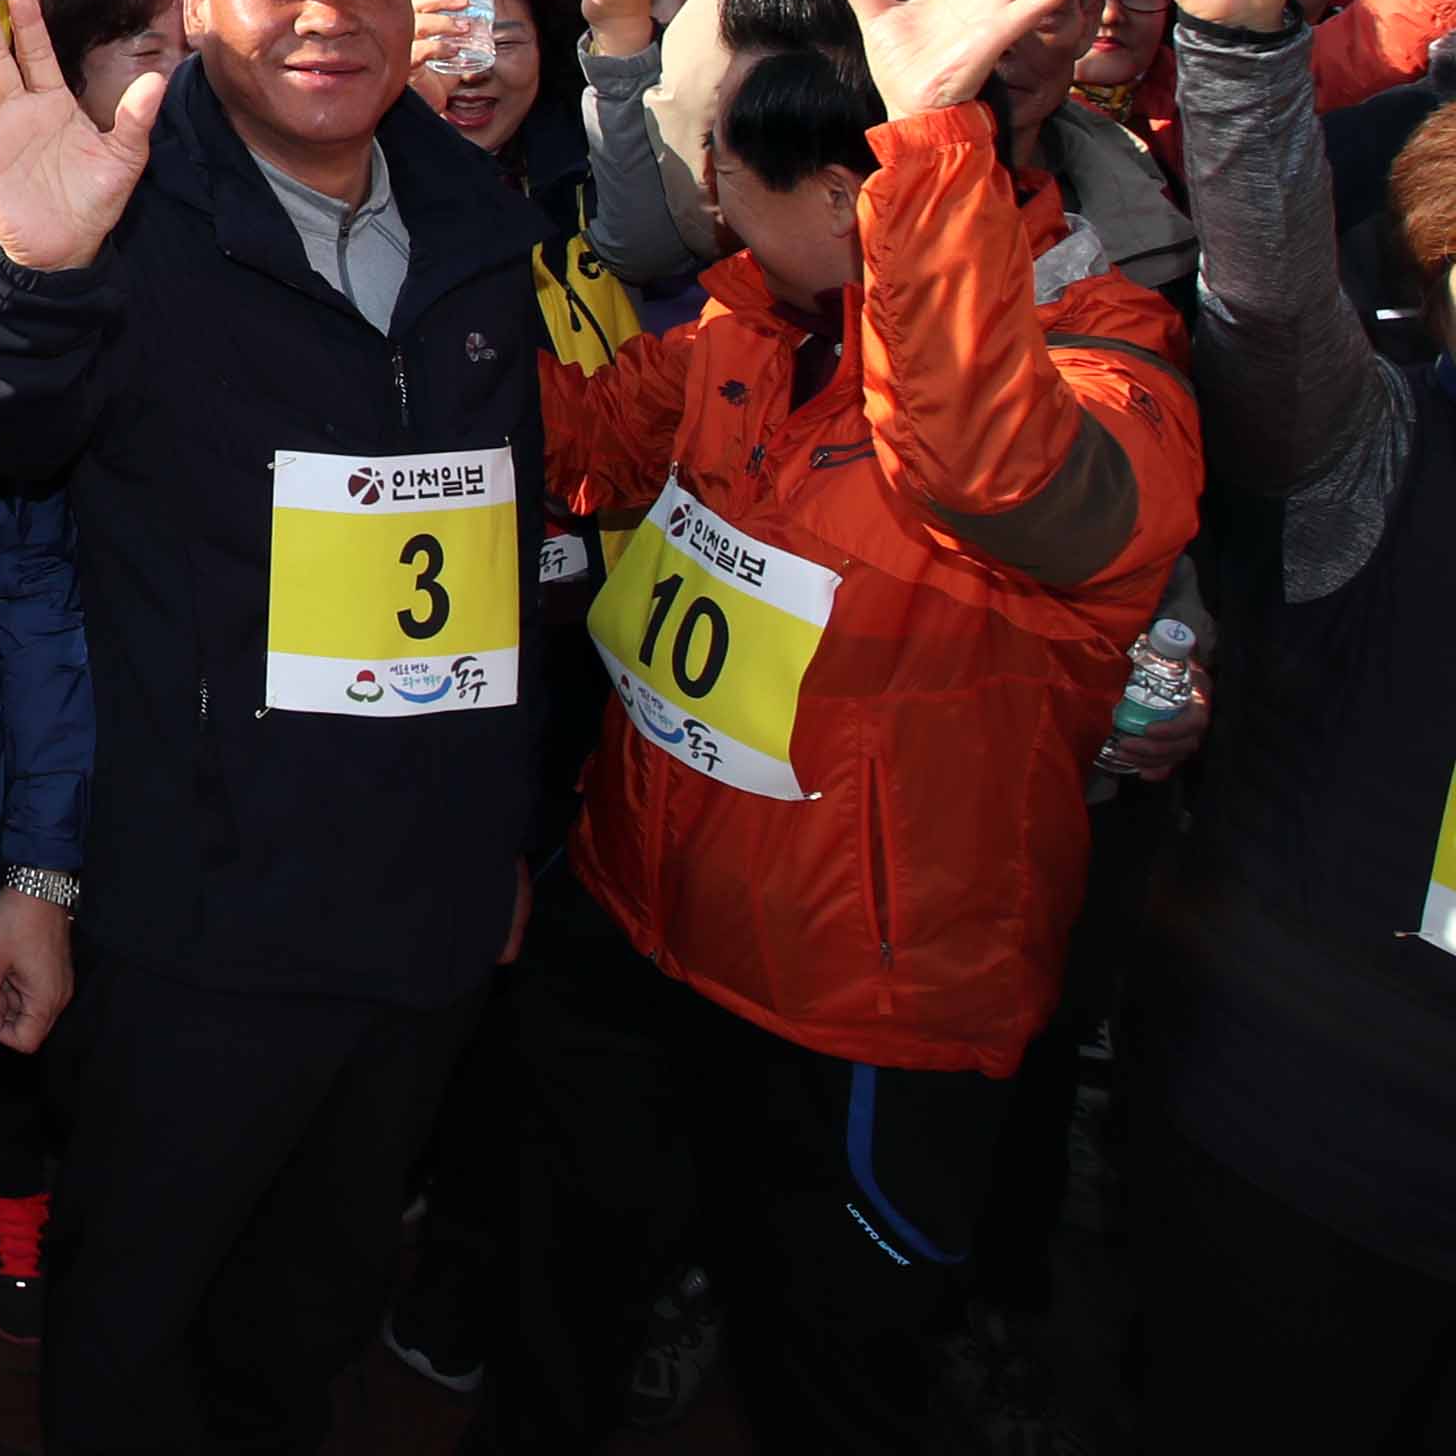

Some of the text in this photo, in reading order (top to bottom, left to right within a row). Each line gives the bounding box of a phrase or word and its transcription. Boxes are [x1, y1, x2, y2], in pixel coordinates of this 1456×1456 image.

[392, 465, 485, 501] 인천일보
[396, 533, 450, 640] 3
[689, 518, 767, 588] 인천일보
[638, 573, 730, 699] 10
[451, 656, 488, 704] 동구
